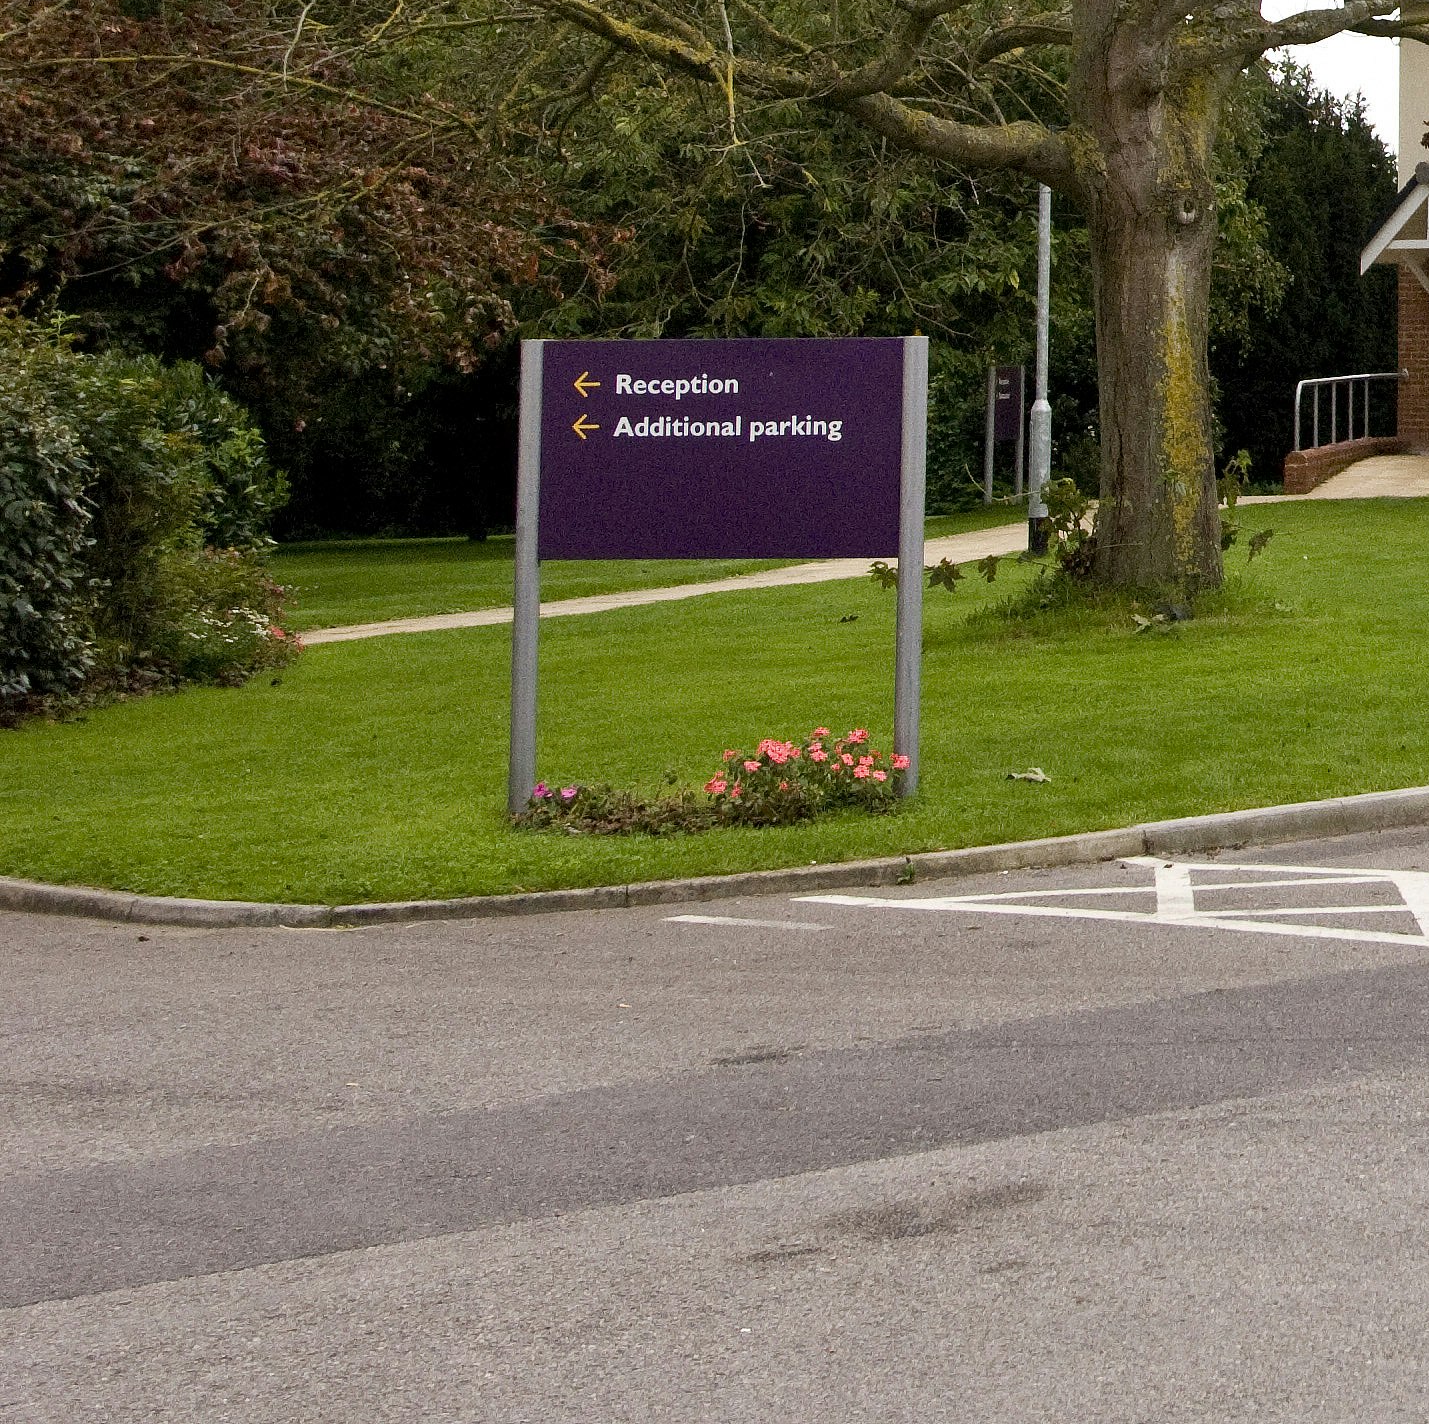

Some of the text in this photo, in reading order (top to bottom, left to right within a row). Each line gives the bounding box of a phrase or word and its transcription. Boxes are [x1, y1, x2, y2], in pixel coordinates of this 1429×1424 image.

[615, 373, 739, 401] Reception
[612, 415, 843, 442] Additional parking
